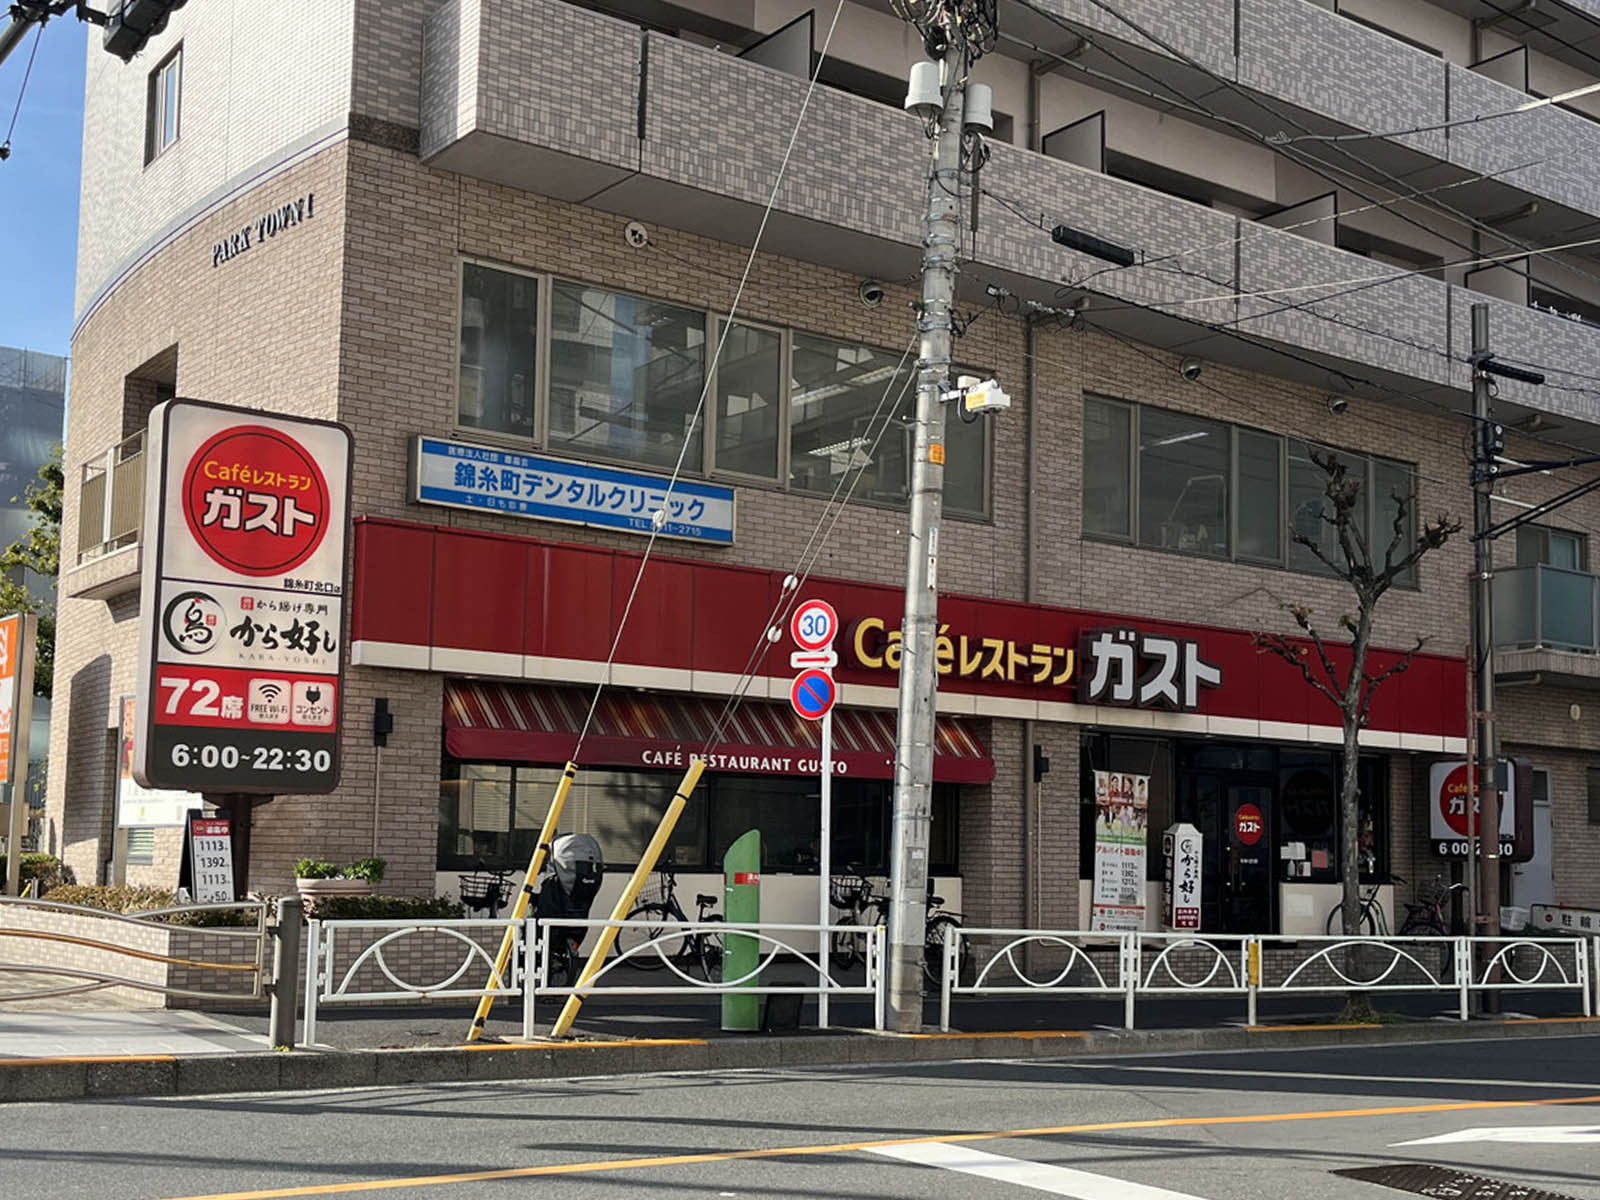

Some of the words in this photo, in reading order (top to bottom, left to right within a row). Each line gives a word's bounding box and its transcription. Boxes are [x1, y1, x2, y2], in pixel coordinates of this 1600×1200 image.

[212, 225, 251, 267] PARK
[256, 198, 304, 243] TOWN
[203, 461, 311, 490] Caféレストラン
[454, 462, 705, 521] 錦糸町デンタルクリニック
[203, 488, 316, 536] ガスト
[628, 518, 647, 528] TEL
[257, 600, 328, 616] から揚げ専門
[230, 615, 336, 656] から好し
[802, 614, 828, 637] 30
[854, 617, 1074, 685] Caéレストラン
[1090, 630, 1221, 707] ガスト
[251, 704, 267, 712] FREE
[296, 705, 329, 715] コンセント
[642, 746, 682, 765] CAFÉ
[1178, 854, 1195, 903] から好し
[1561, 913, 1600, 928] 駐輪
